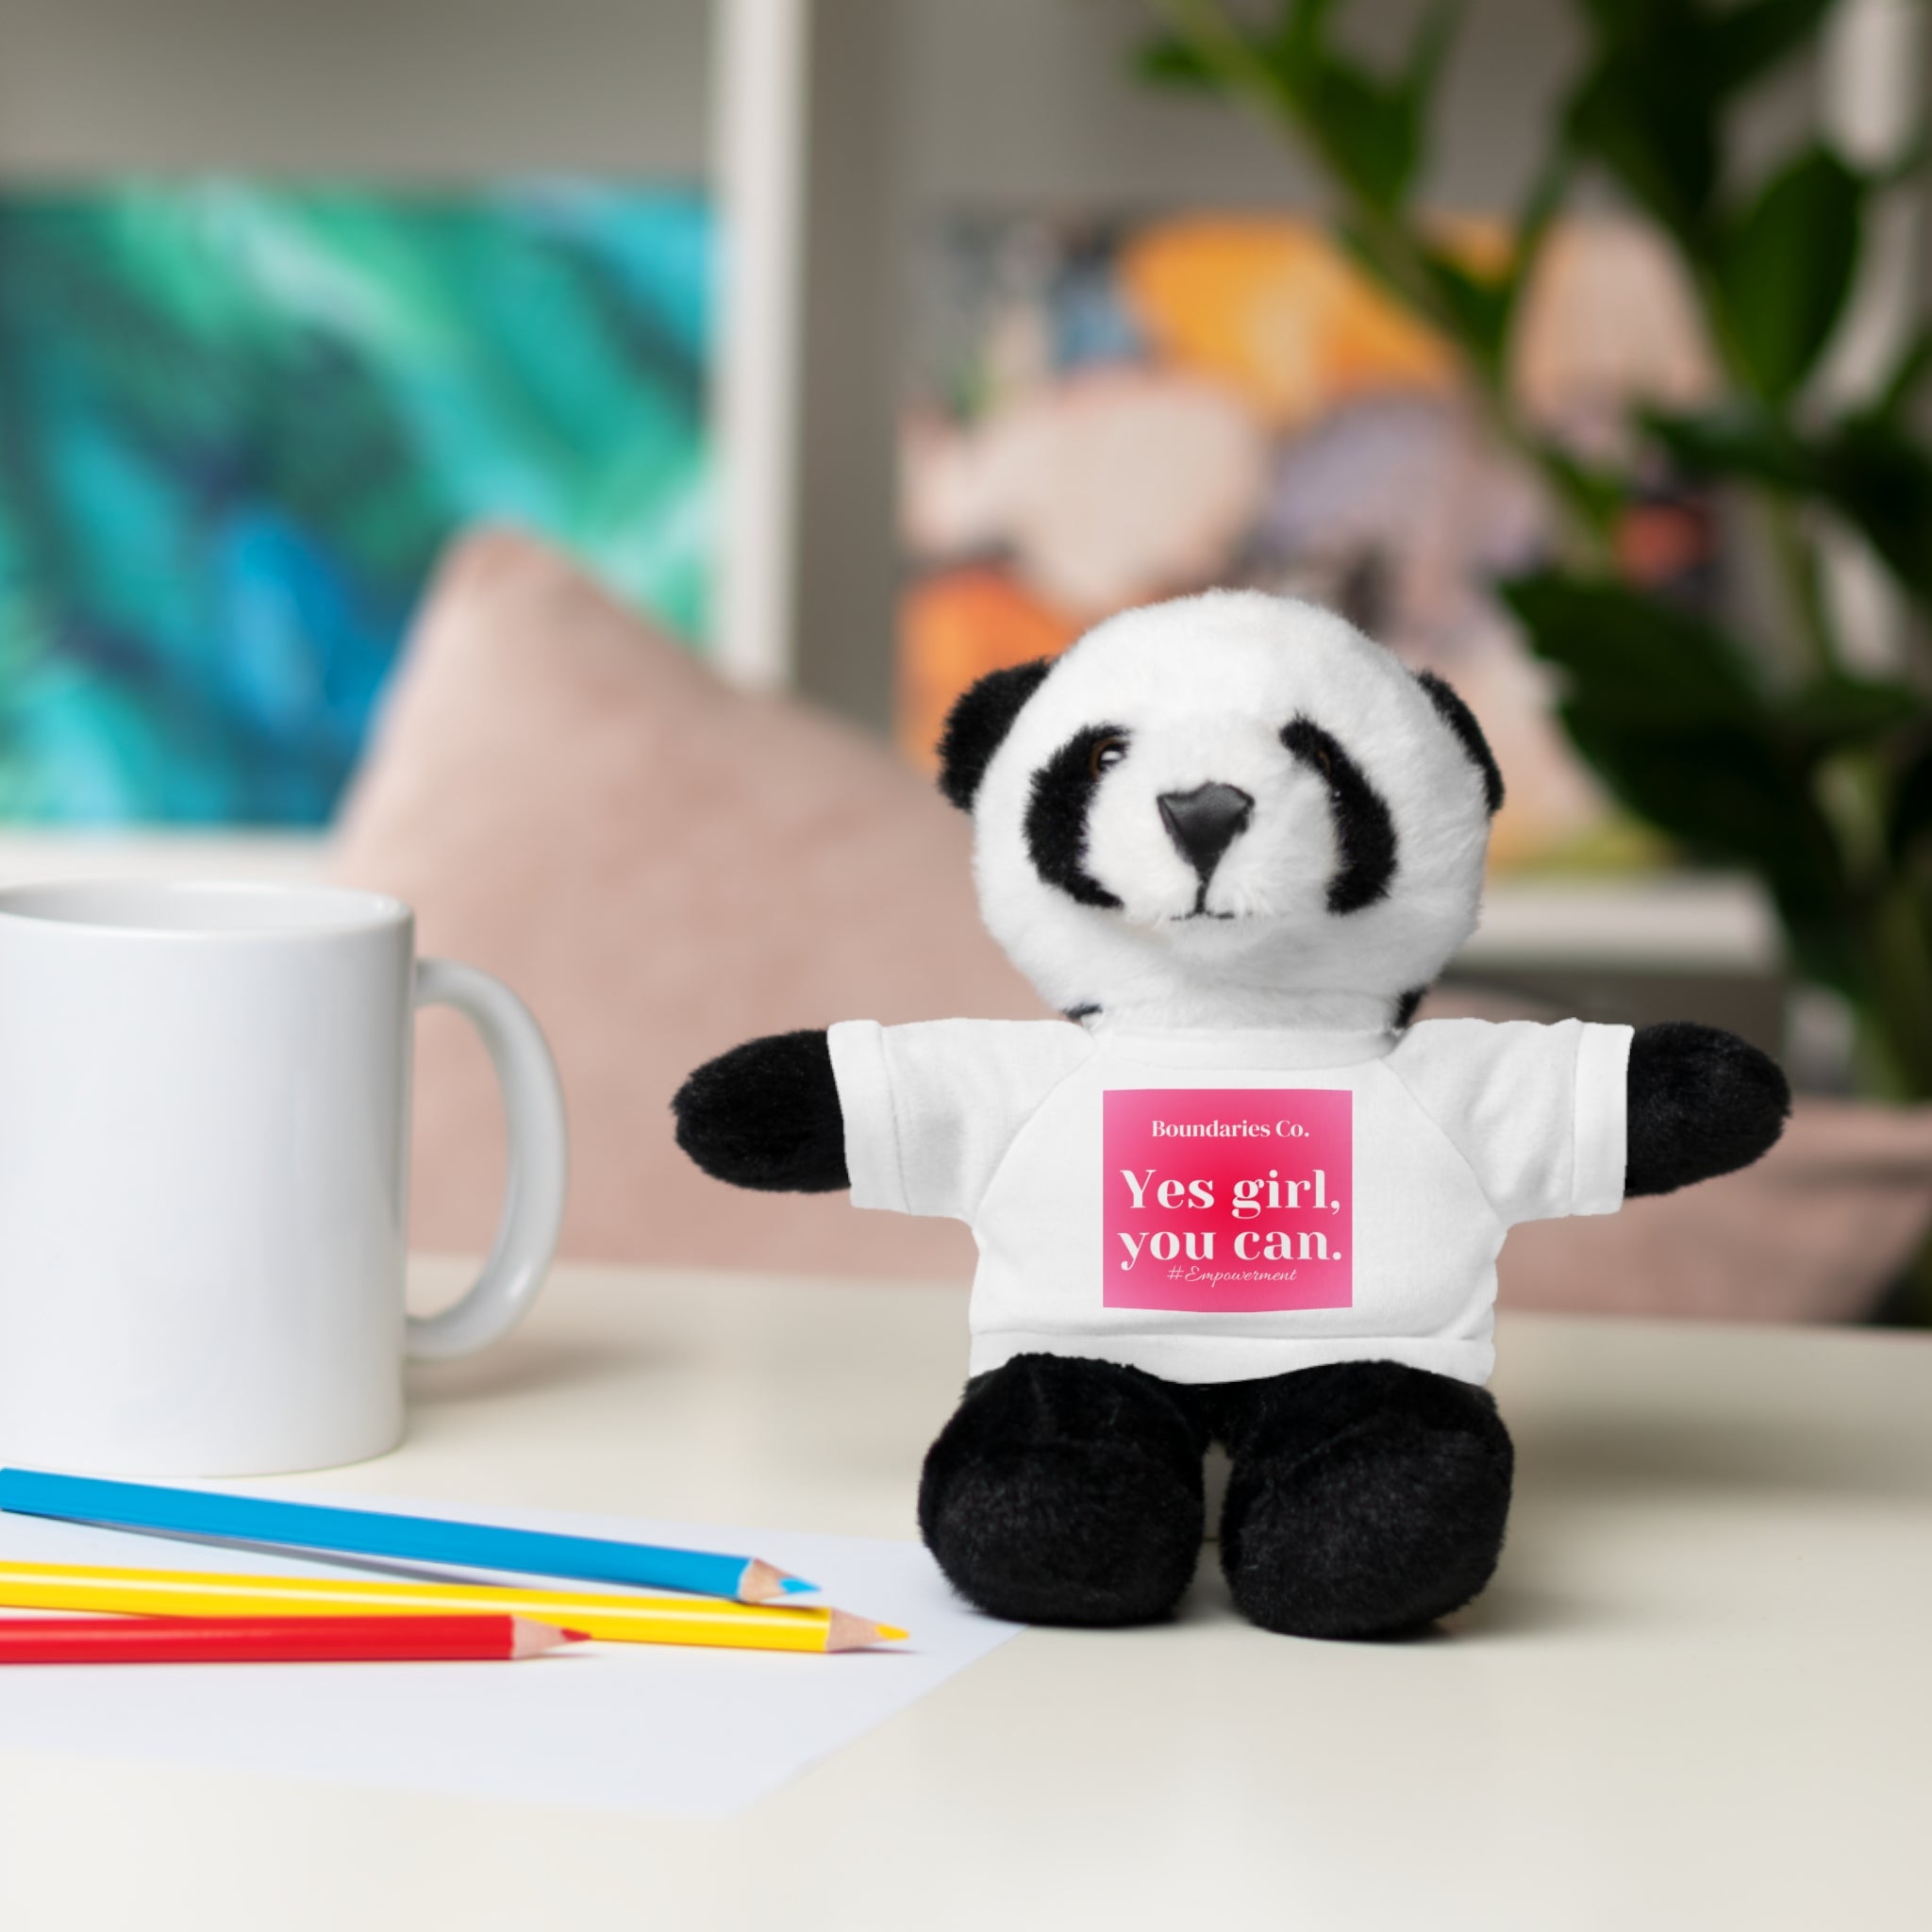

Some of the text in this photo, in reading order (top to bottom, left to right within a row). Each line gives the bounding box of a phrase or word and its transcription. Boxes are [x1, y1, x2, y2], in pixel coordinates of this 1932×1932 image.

[1151, 1119, 1310, 1138] Boundaries Co.
[1120, 1169, 1341, 1219] Yes girl,
[1117, 1231, 1341, 1271] you can.
[1166, 1265, 1298, 1288] #Empowerment
